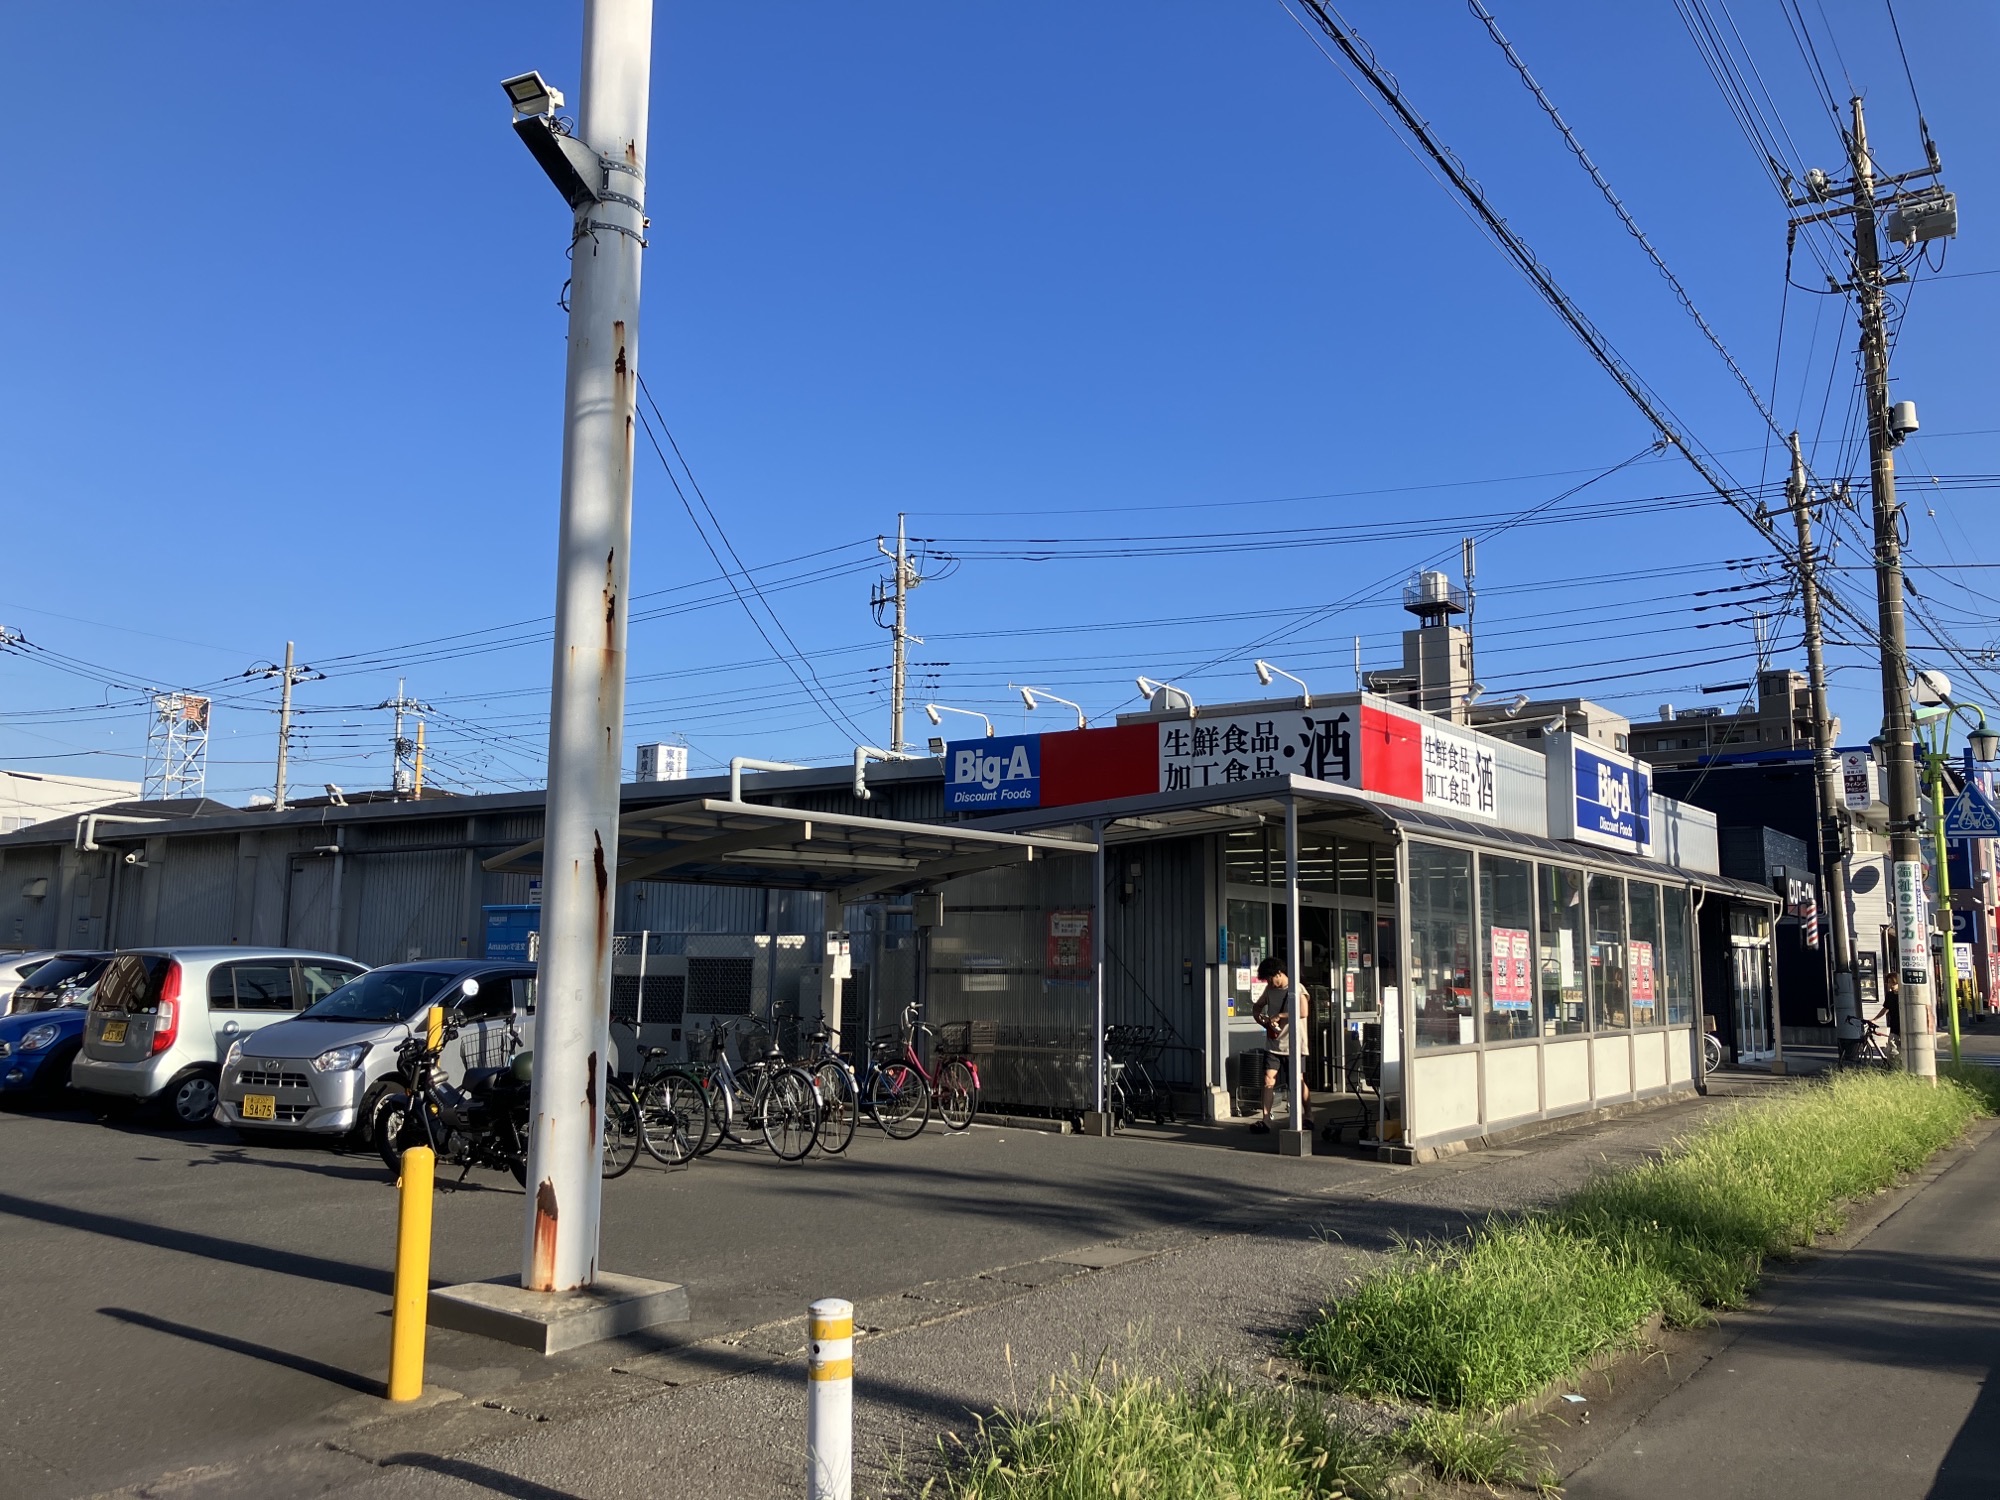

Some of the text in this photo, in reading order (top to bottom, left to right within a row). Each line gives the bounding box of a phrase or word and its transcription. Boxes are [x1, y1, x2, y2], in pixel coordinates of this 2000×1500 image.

[1164, 720, 1279, 758] 生鮮食品
[1424, 735, 1470, 775] 生鮮食品
[955, 746, 1032, 790] Big-A
[1425, 767, 1471, 808] 加工食品
[954, 787, 1032, 803] Discount Foods
[1597, 762, 1632, 819] Big-A
[1599, 816, 1632, 837] Discount Foods
